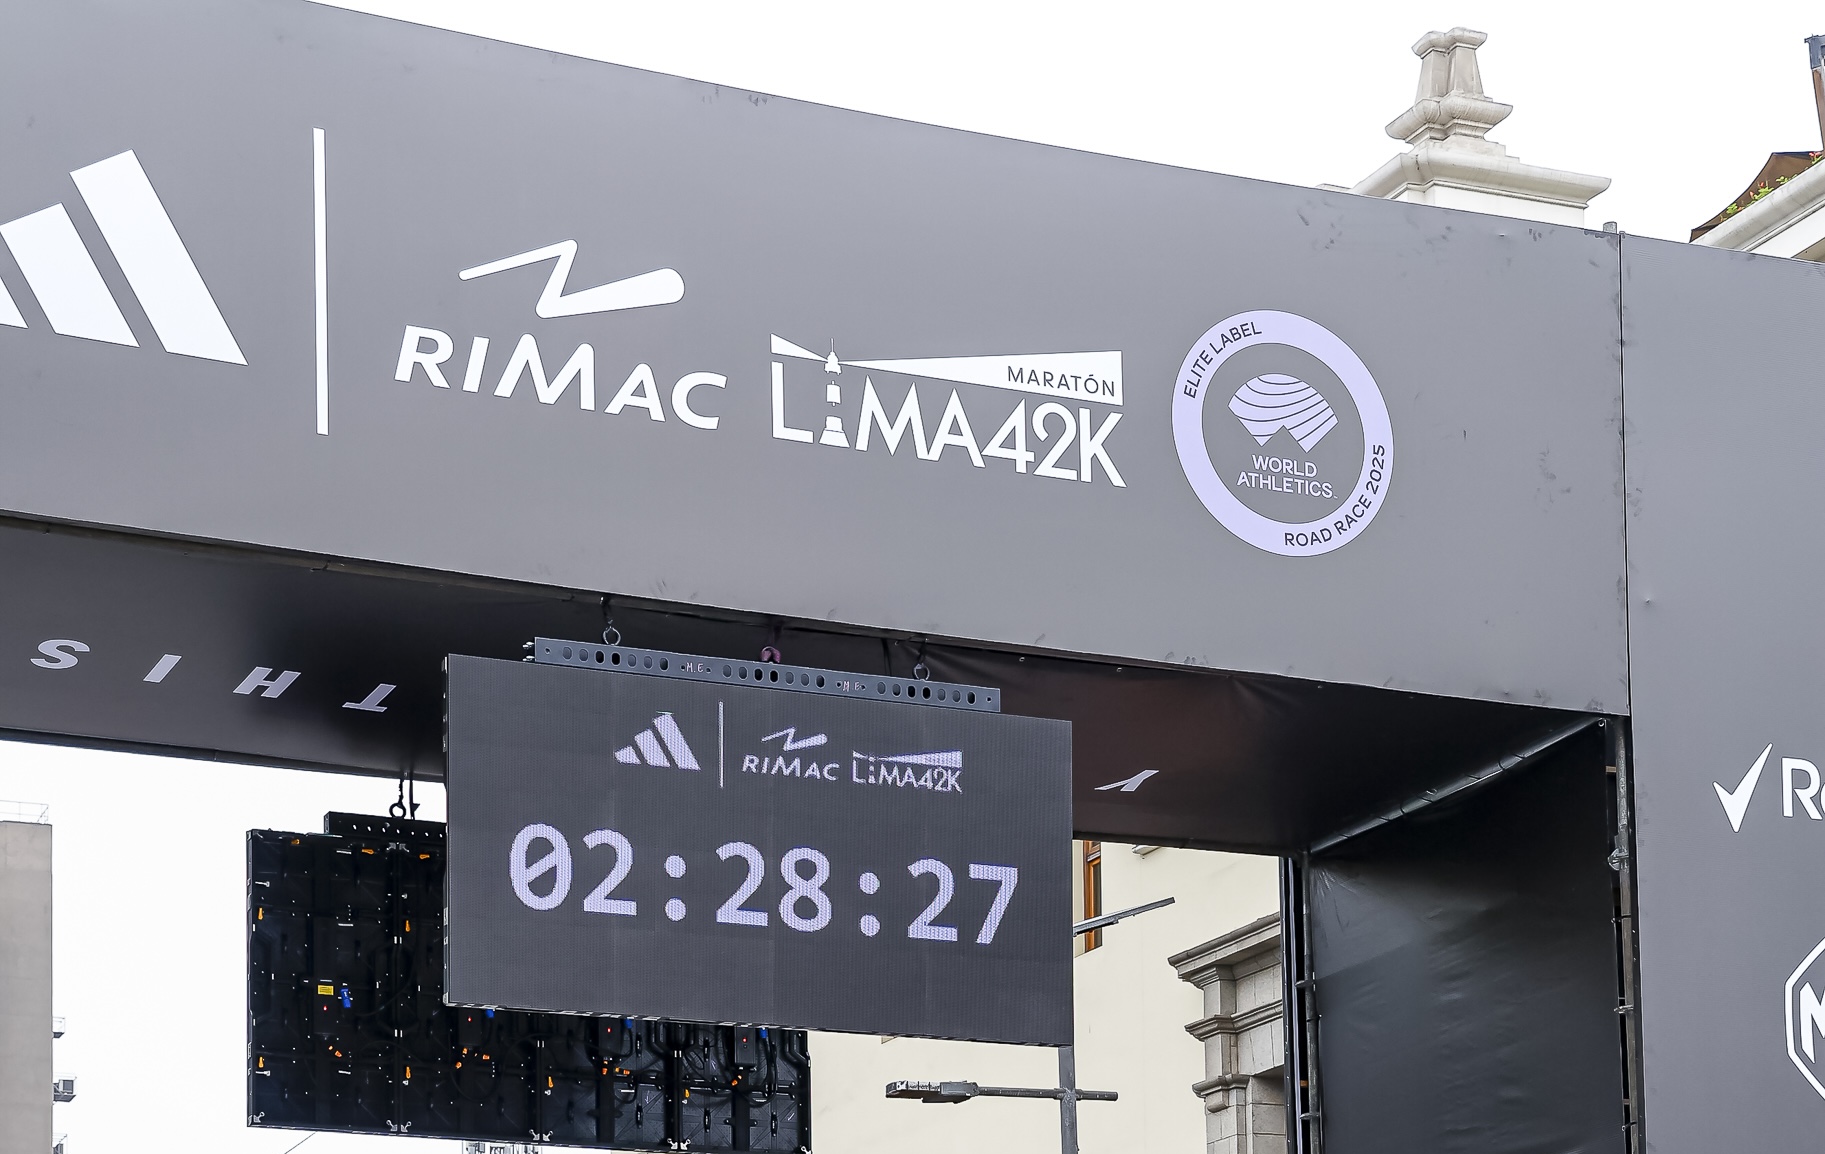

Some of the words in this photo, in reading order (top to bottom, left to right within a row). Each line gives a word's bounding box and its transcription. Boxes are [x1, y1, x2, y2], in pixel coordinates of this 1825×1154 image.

[395, 325, 727, 430] RIMAC
[1007, 365, 1115, 397] MARATÓN
[1184, 350, 1214, 399] ELITE
[1209, 321, 1263, 355] LABEL
[1237, 472, 1333, 499] ATHLETICS
[1252, 455, 1317, 478] WORLD
[1284, 527, 1332, 547] ROAD
[1334, 494, 1372, 536] RACE
[1365, 444, 1385, 495] 2025
[742, 754, 840, 782] RIMAC
[1782, 757, 1825, 821] R
[510, 823, 1018, 945] 02:28:27
